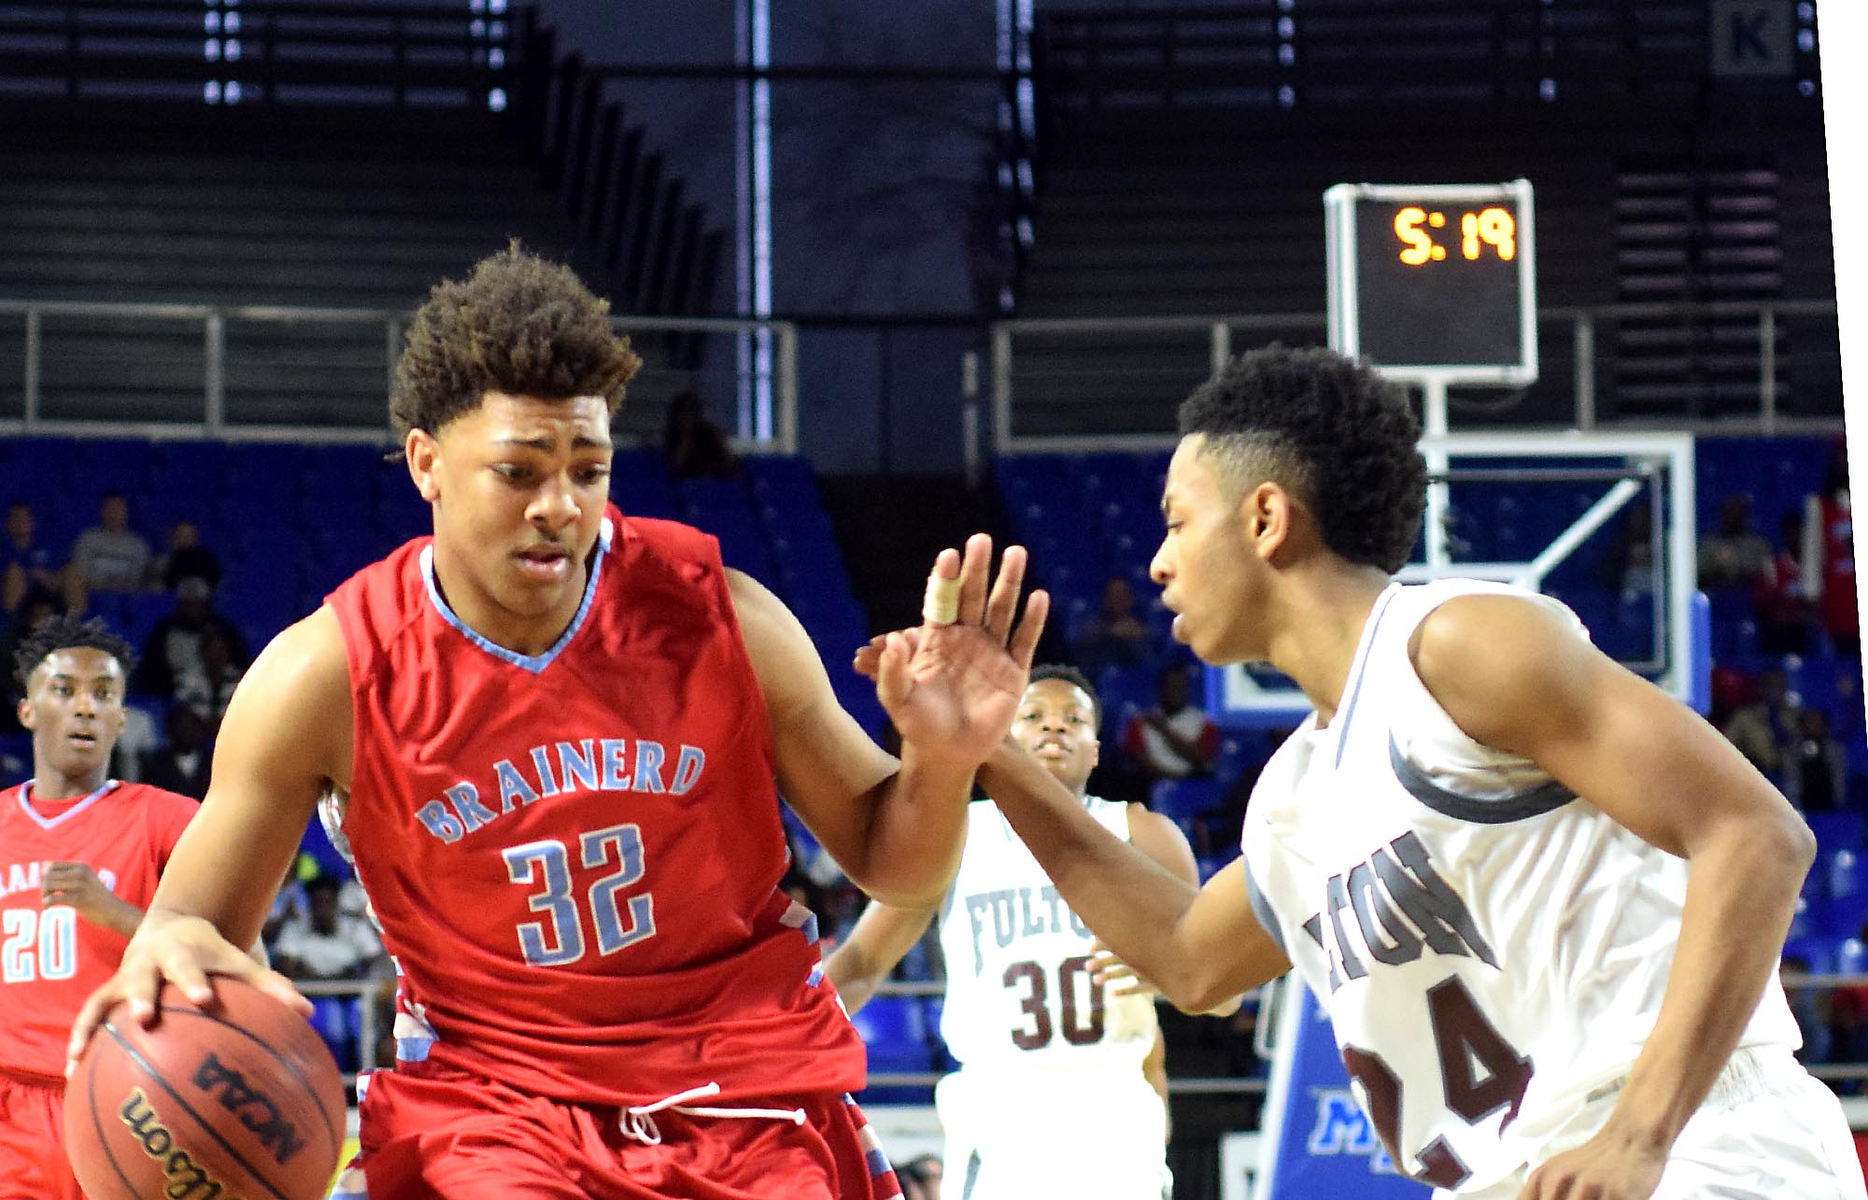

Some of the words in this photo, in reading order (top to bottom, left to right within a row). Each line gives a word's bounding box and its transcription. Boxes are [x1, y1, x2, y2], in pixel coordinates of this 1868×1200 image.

[1729, 10, 1774, 60] K
[1394, 206, 1516, 266] 5:19
[415, 739, 706, 845] BRAINERD
[2, 906, 77, 984] 20
[501, 823, 657, 967] 32
[1302, 830, 1503, 997] TON
[1003, 955, 1106, 1051] 30
[192, 1052, 306, 1166] NCAA
